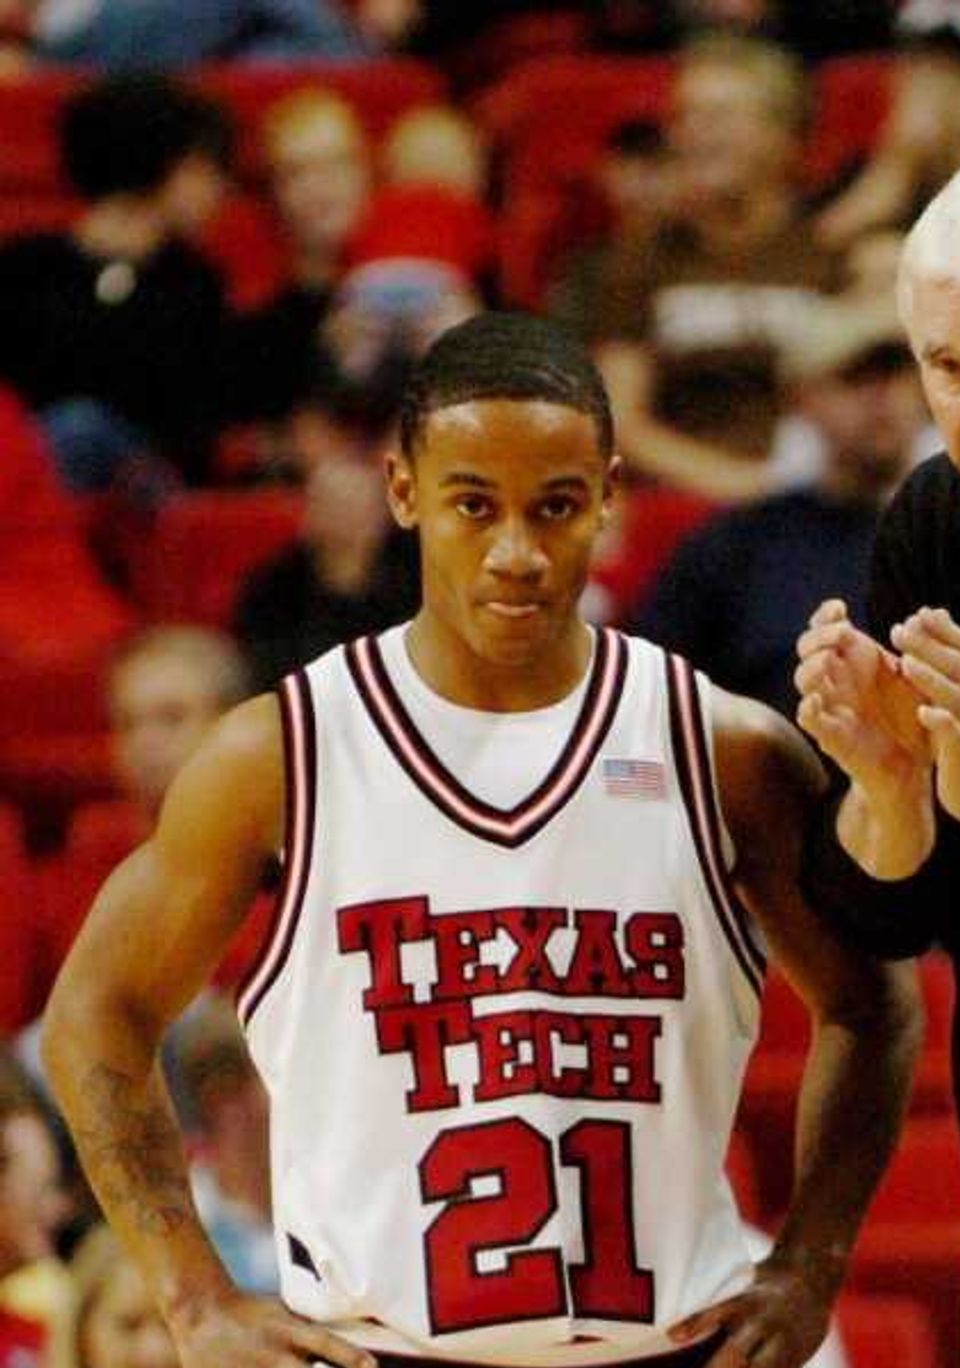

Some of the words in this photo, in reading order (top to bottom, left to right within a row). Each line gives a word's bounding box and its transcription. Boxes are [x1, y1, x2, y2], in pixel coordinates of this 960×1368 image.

[336, 894, 685, 1011] TEXAS
[374, 1000, 663, 1114] TECH
[416, 1115, 656, 1338] 21
